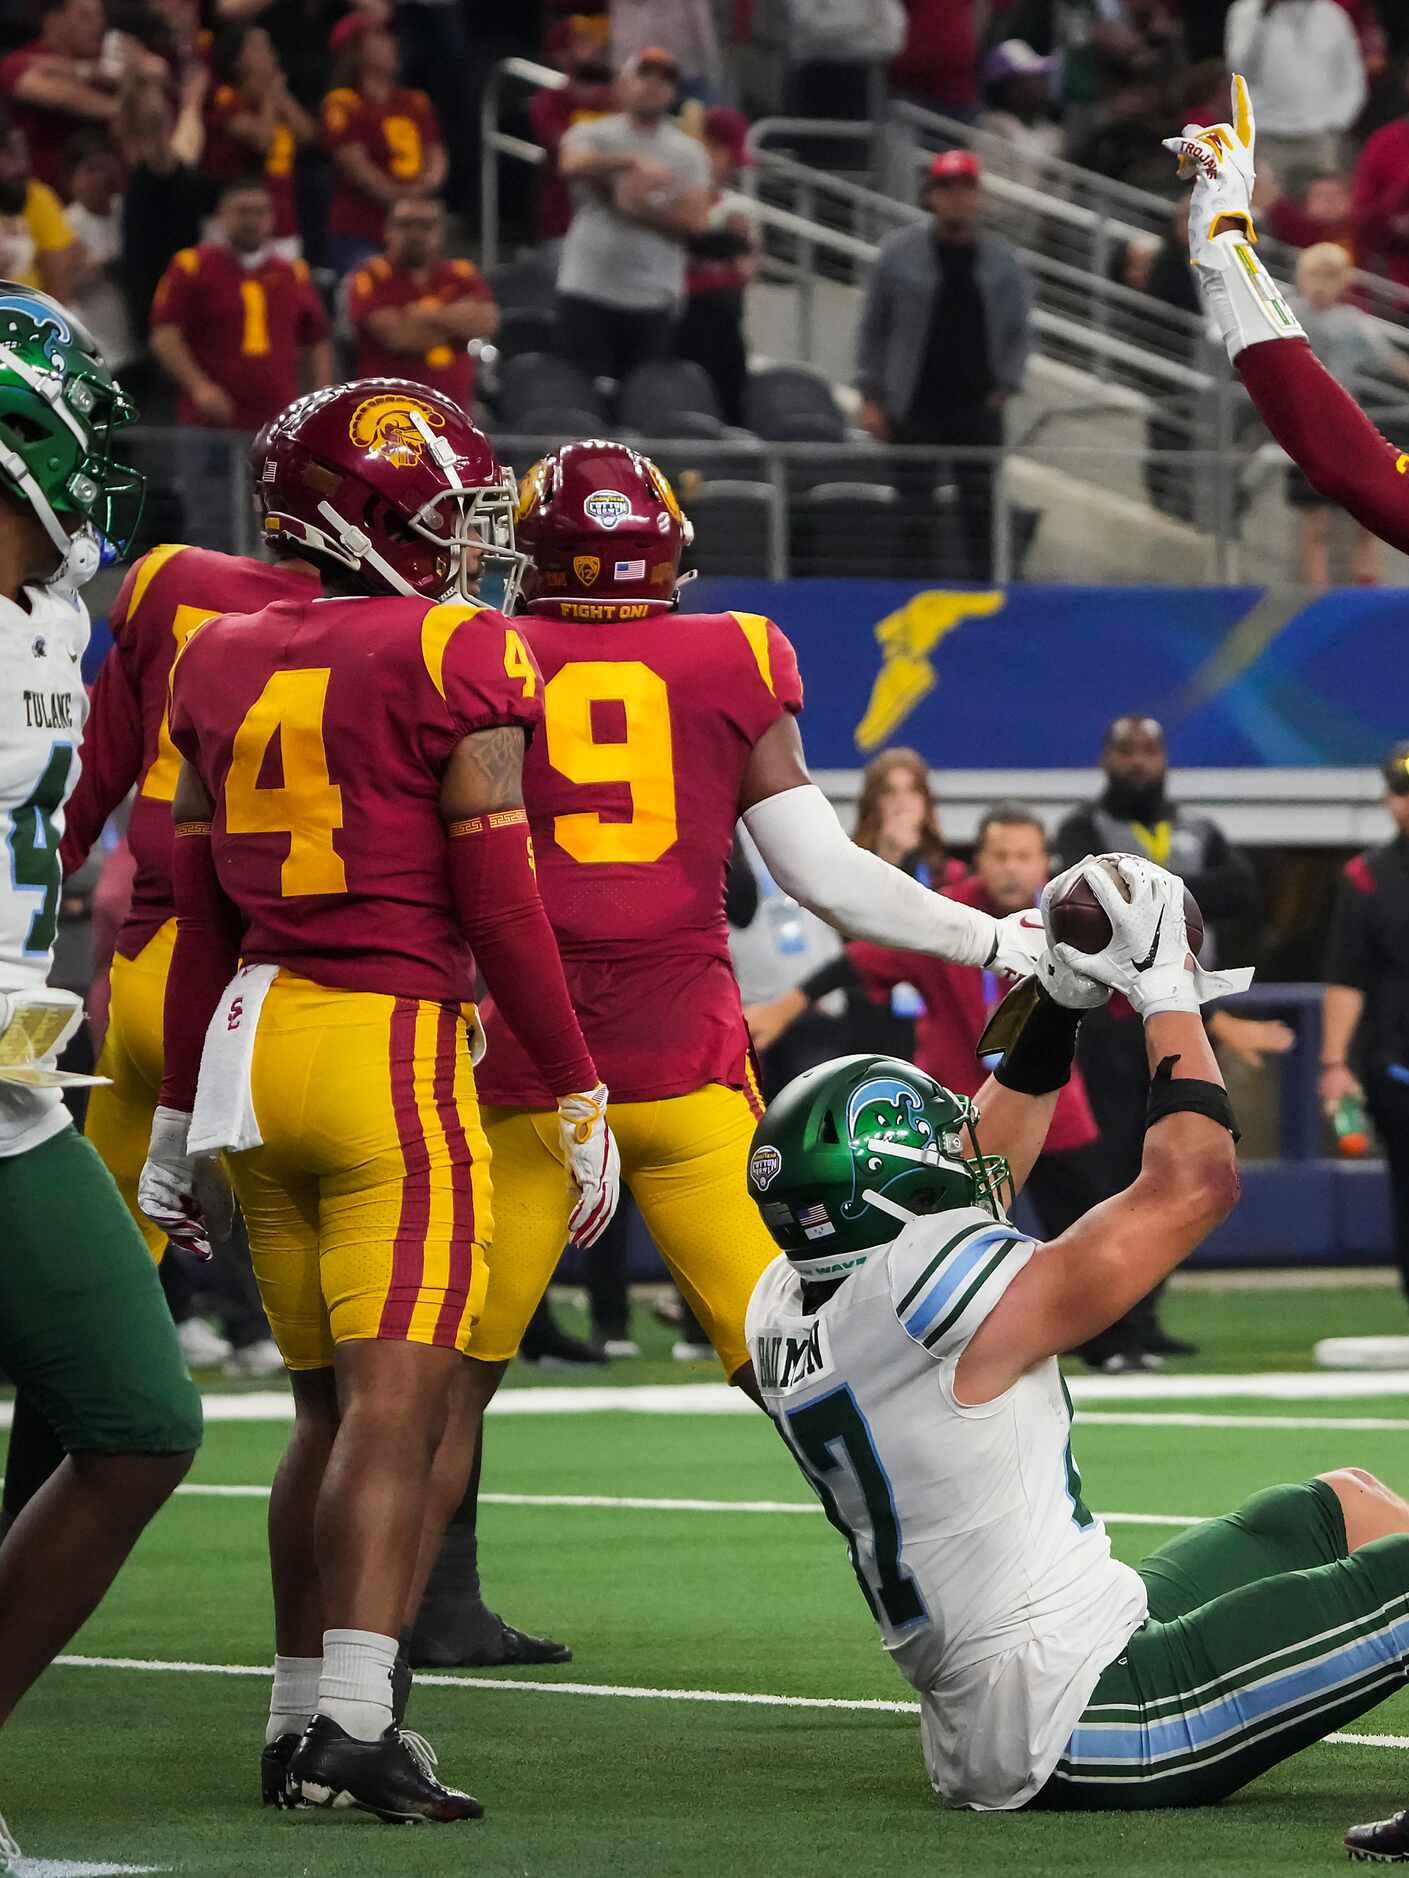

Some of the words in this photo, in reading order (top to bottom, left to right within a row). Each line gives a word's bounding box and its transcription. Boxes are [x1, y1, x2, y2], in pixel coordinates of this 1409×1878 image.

[241, 279, 269, 355] 1
[560, 603, 615, 618] FIGHT
[619, 604, 649, 619] ON!
[504, 630, 536, 697] 4
[23, 690, 72, 728] TULANE
[225, 667, 348, 897] 4
[545, 661, 679, 863] 9
[7, 741, 73, 957] 4
